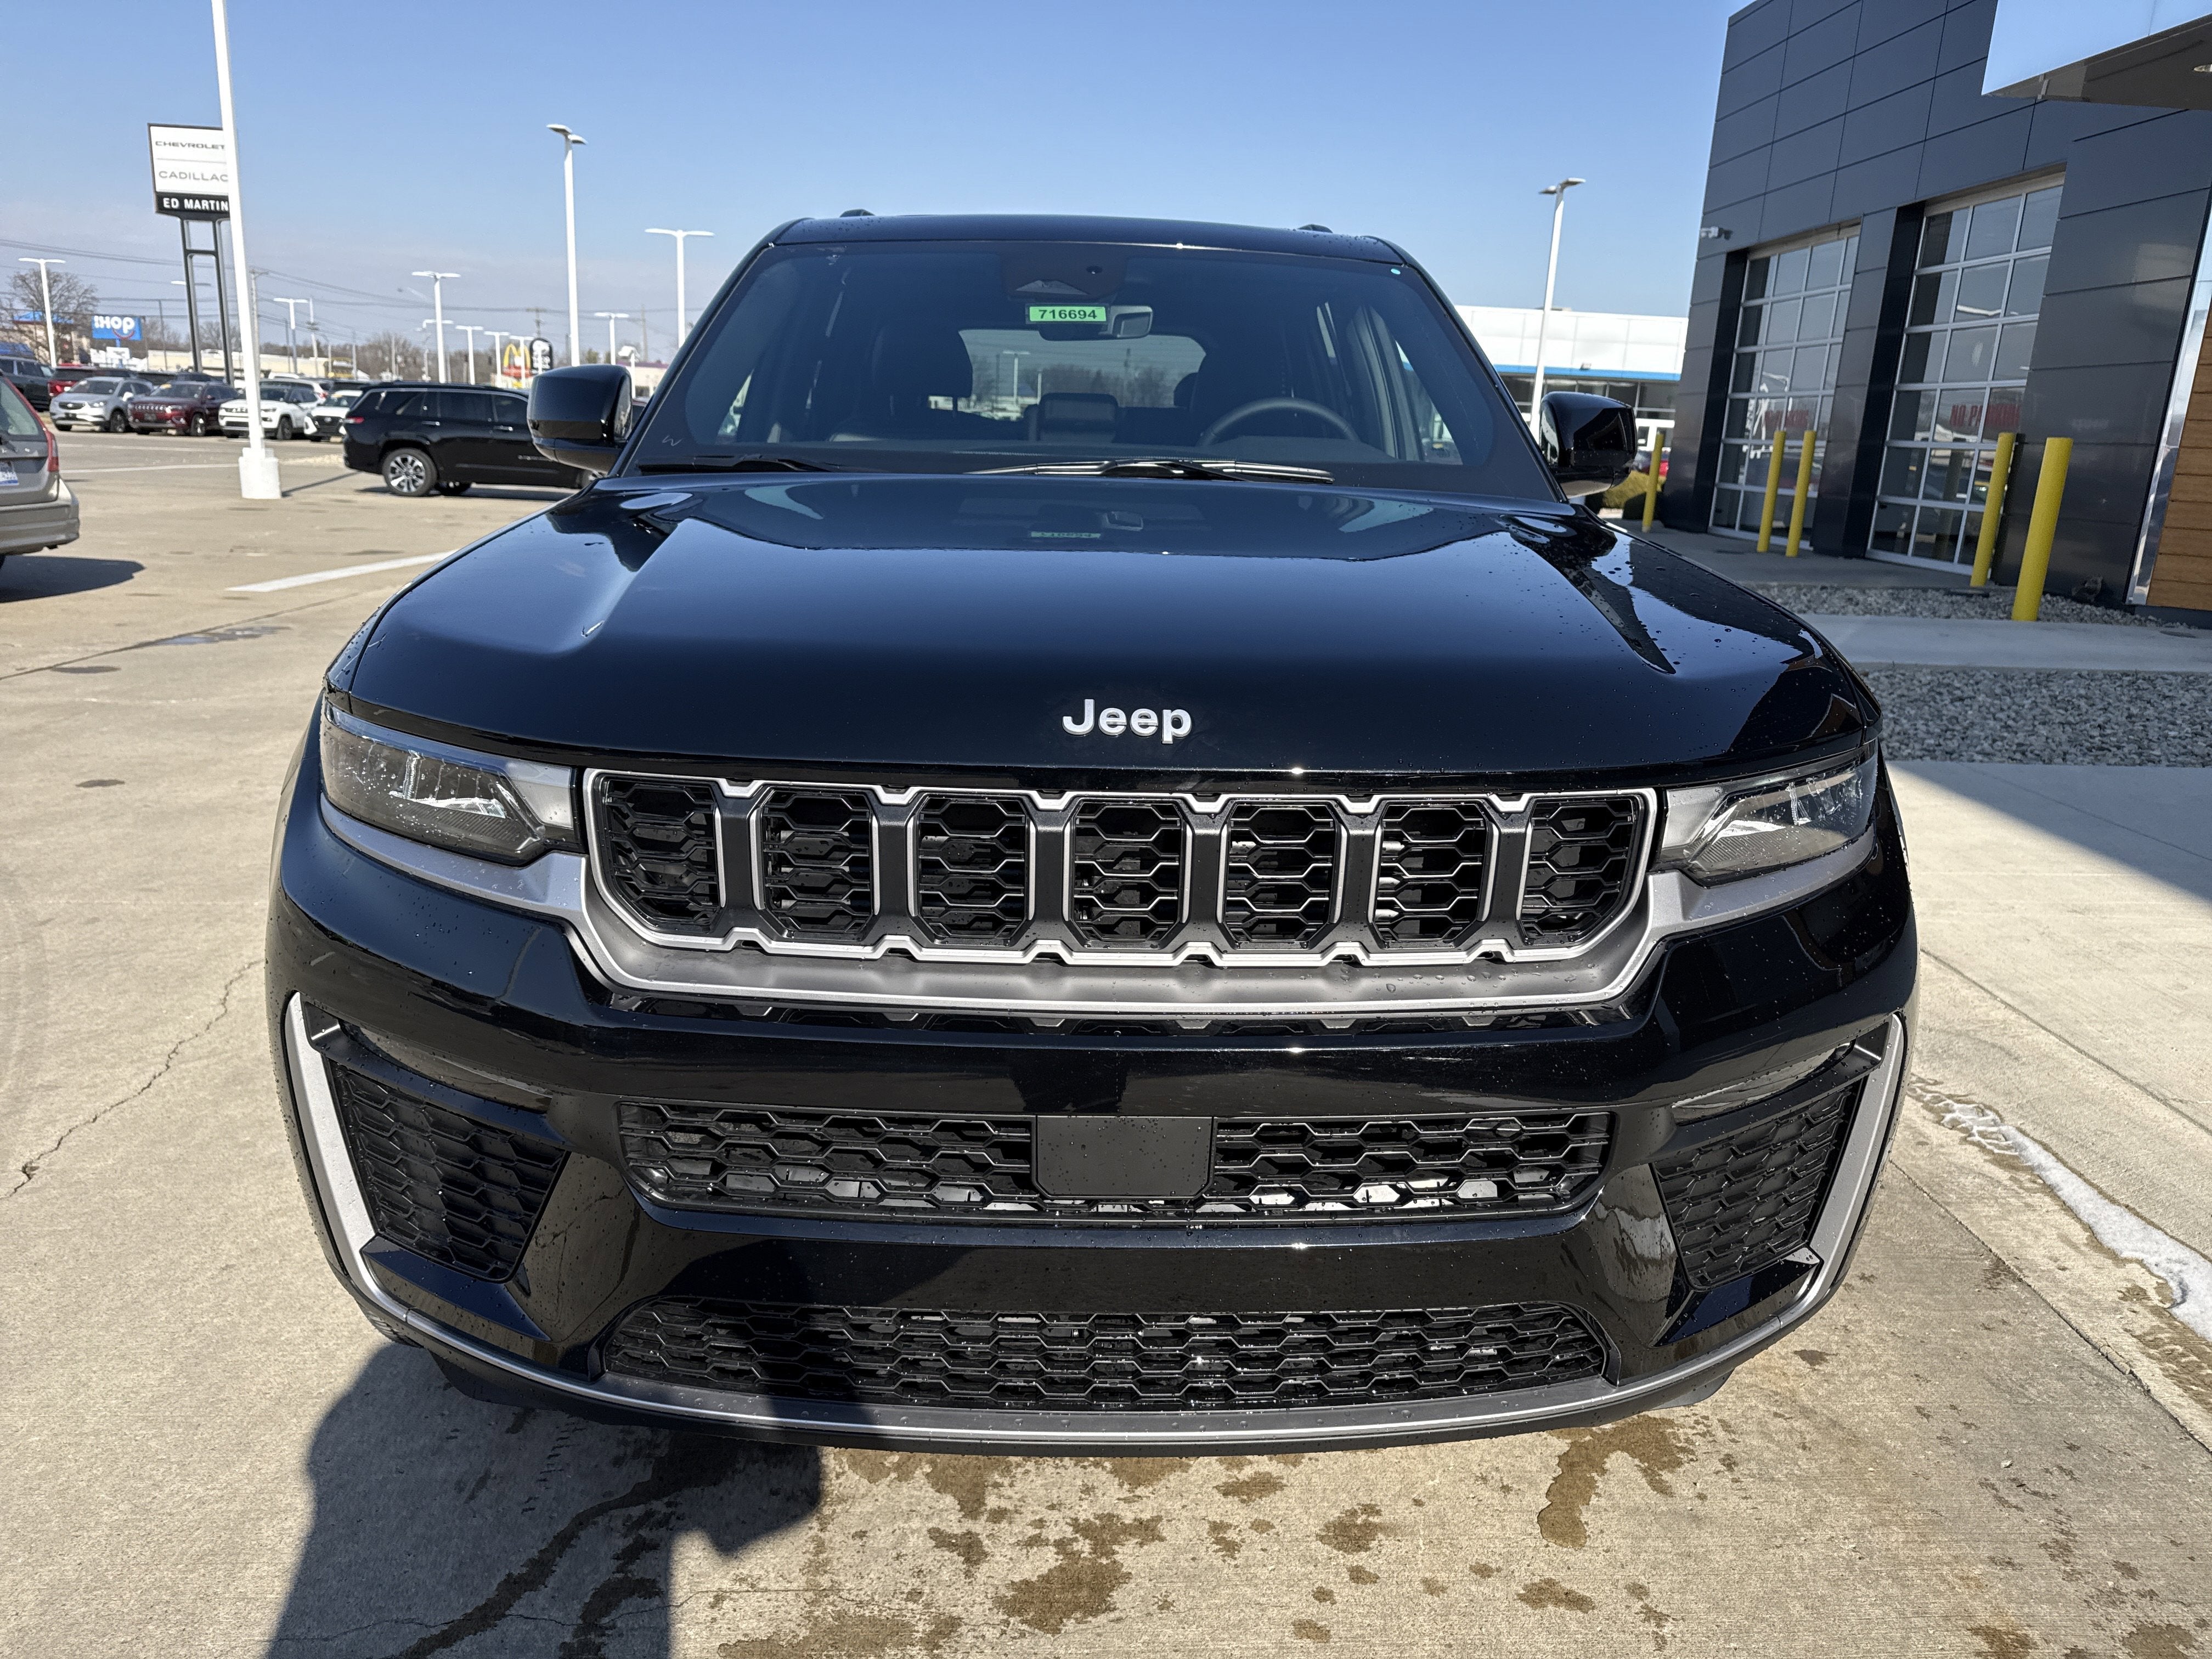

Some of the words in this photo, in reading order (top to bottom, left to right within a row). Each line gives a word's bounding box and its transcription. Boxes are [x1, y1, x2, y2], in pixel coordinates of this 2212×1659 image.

[155, 140, 225, 150] CHEVROLET
[159, 171, 228, 182] CADILLAC
[163, 198, 179, 208] ED
[184, 199, 229, 211] MARTIN
[1039, 309, 1097, 319] 716694
[1062, 698, 1192, 744] Jeep
